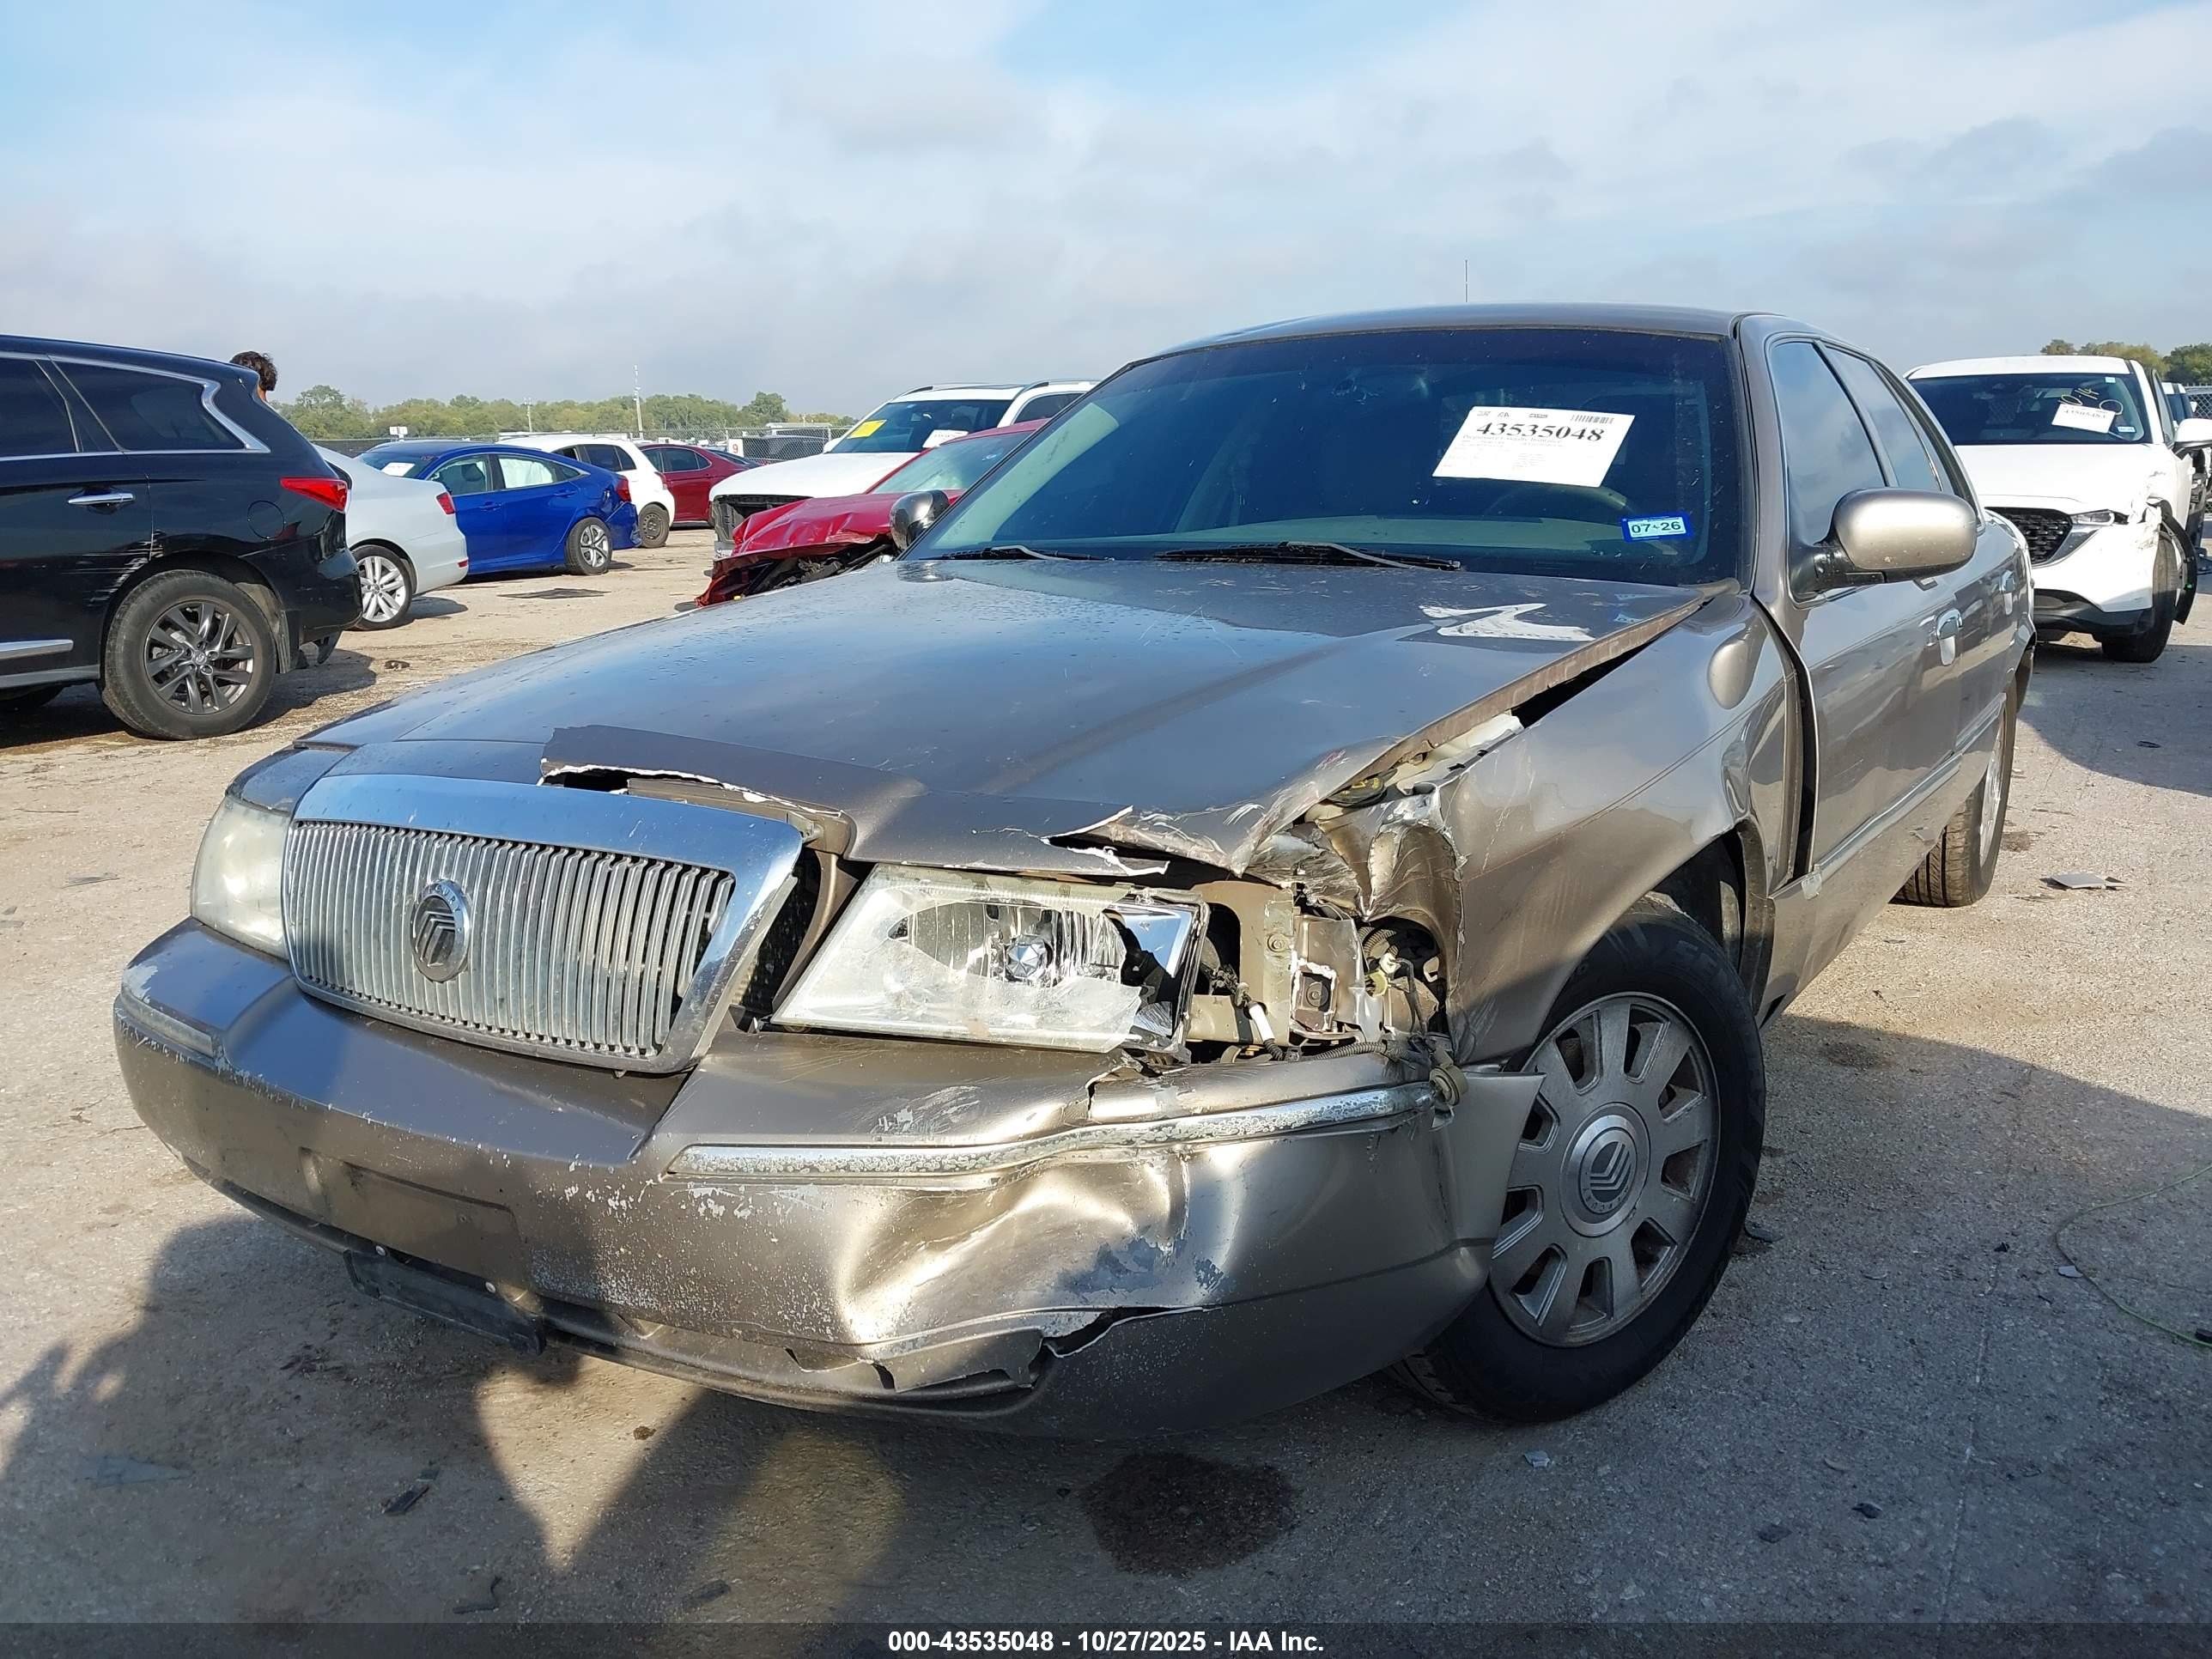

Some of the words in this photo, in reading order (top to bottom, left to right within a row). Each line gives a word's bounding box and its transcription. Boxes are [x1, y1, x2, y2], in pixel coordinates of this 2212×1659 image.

[1476, 422, 1604, 441] 43535048
[732, 443, 738, 453] 9
[1631, 524, 1650, 533] 07
[1661, 521, 1680, 531] 26
